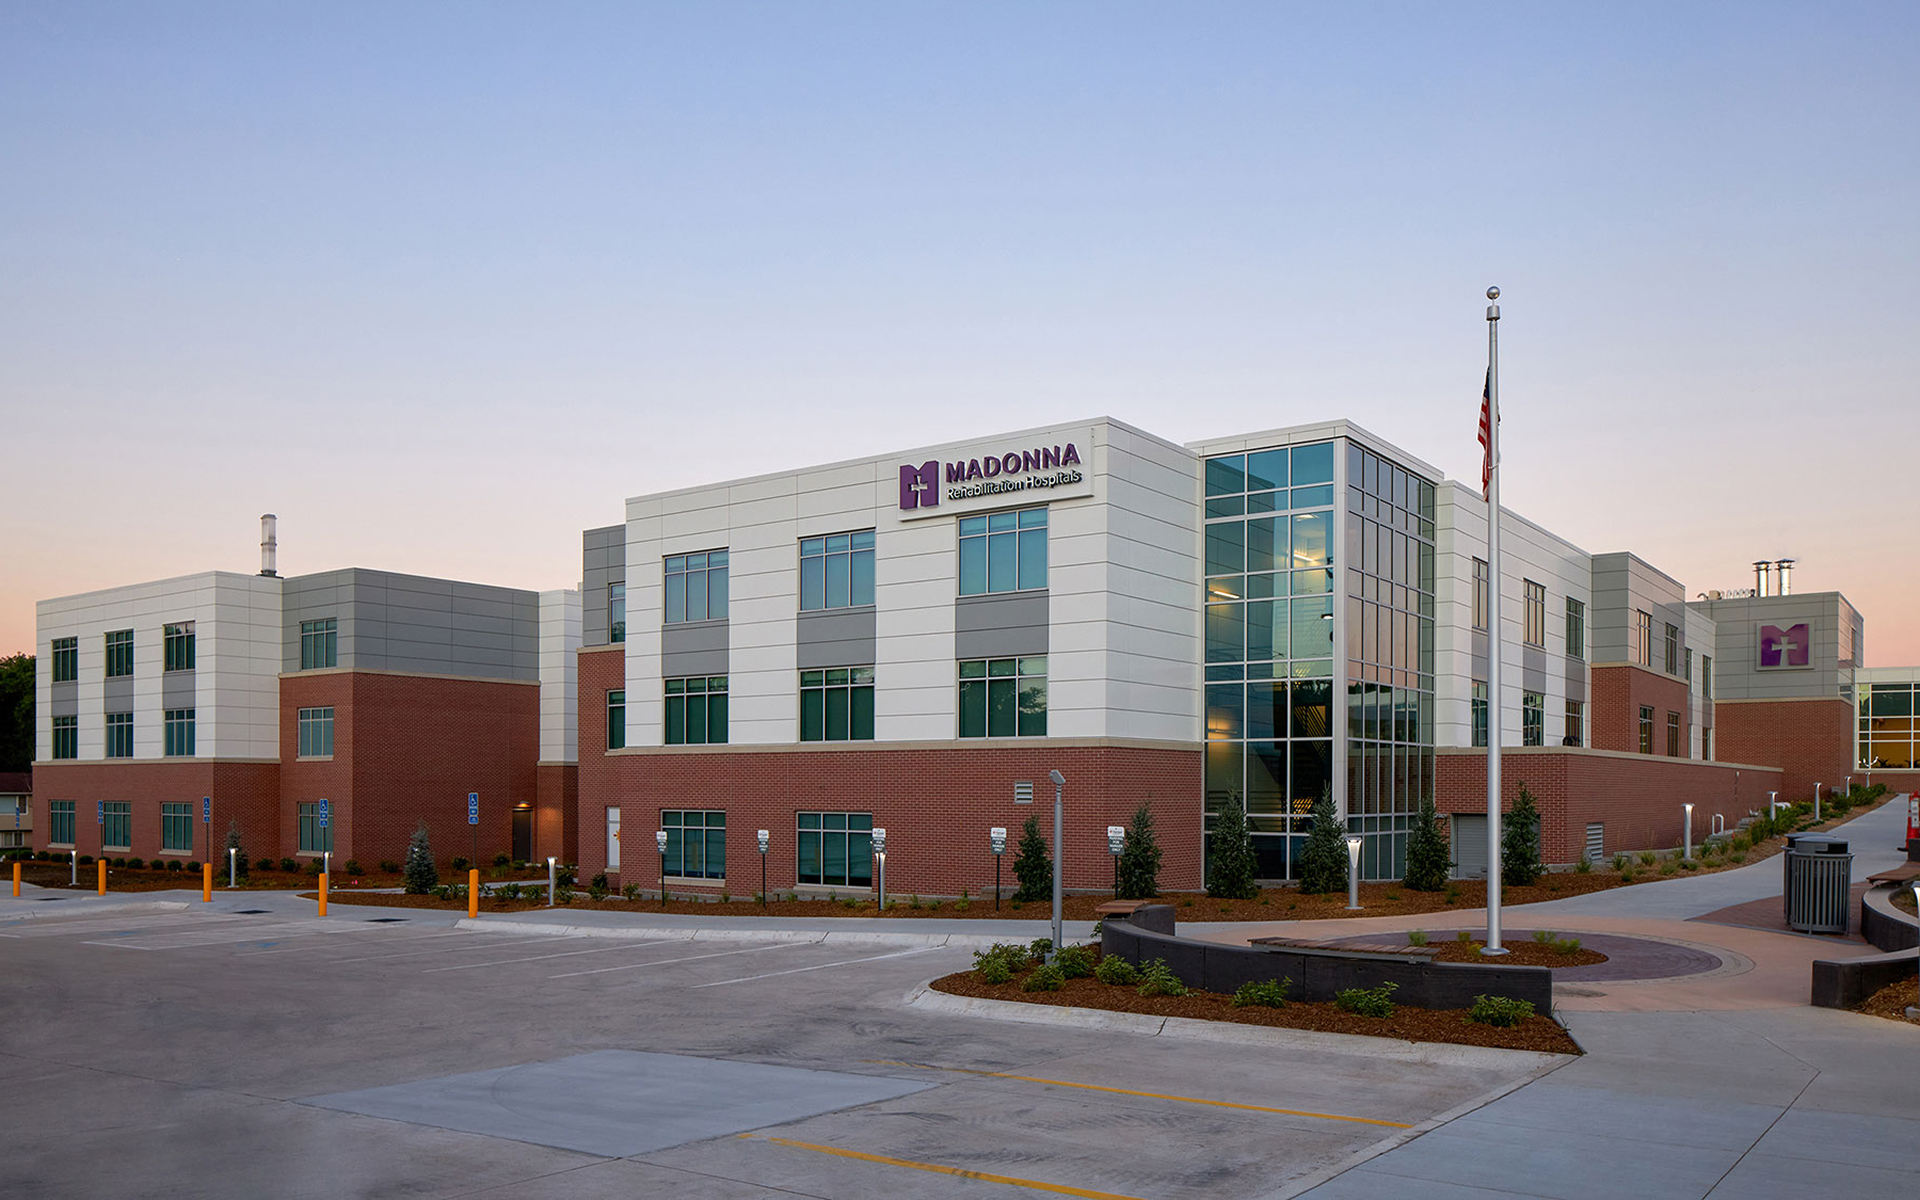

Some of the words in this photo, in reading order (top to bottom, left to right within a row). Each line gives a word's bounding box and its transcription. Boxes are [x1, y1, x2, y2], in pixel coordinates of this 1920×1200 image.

[945, 443, 1081, 483] MADONNA
[947, 479, 1025, 500] Rehabilitation
[1025, 469, 1082, 489] Hospitals
